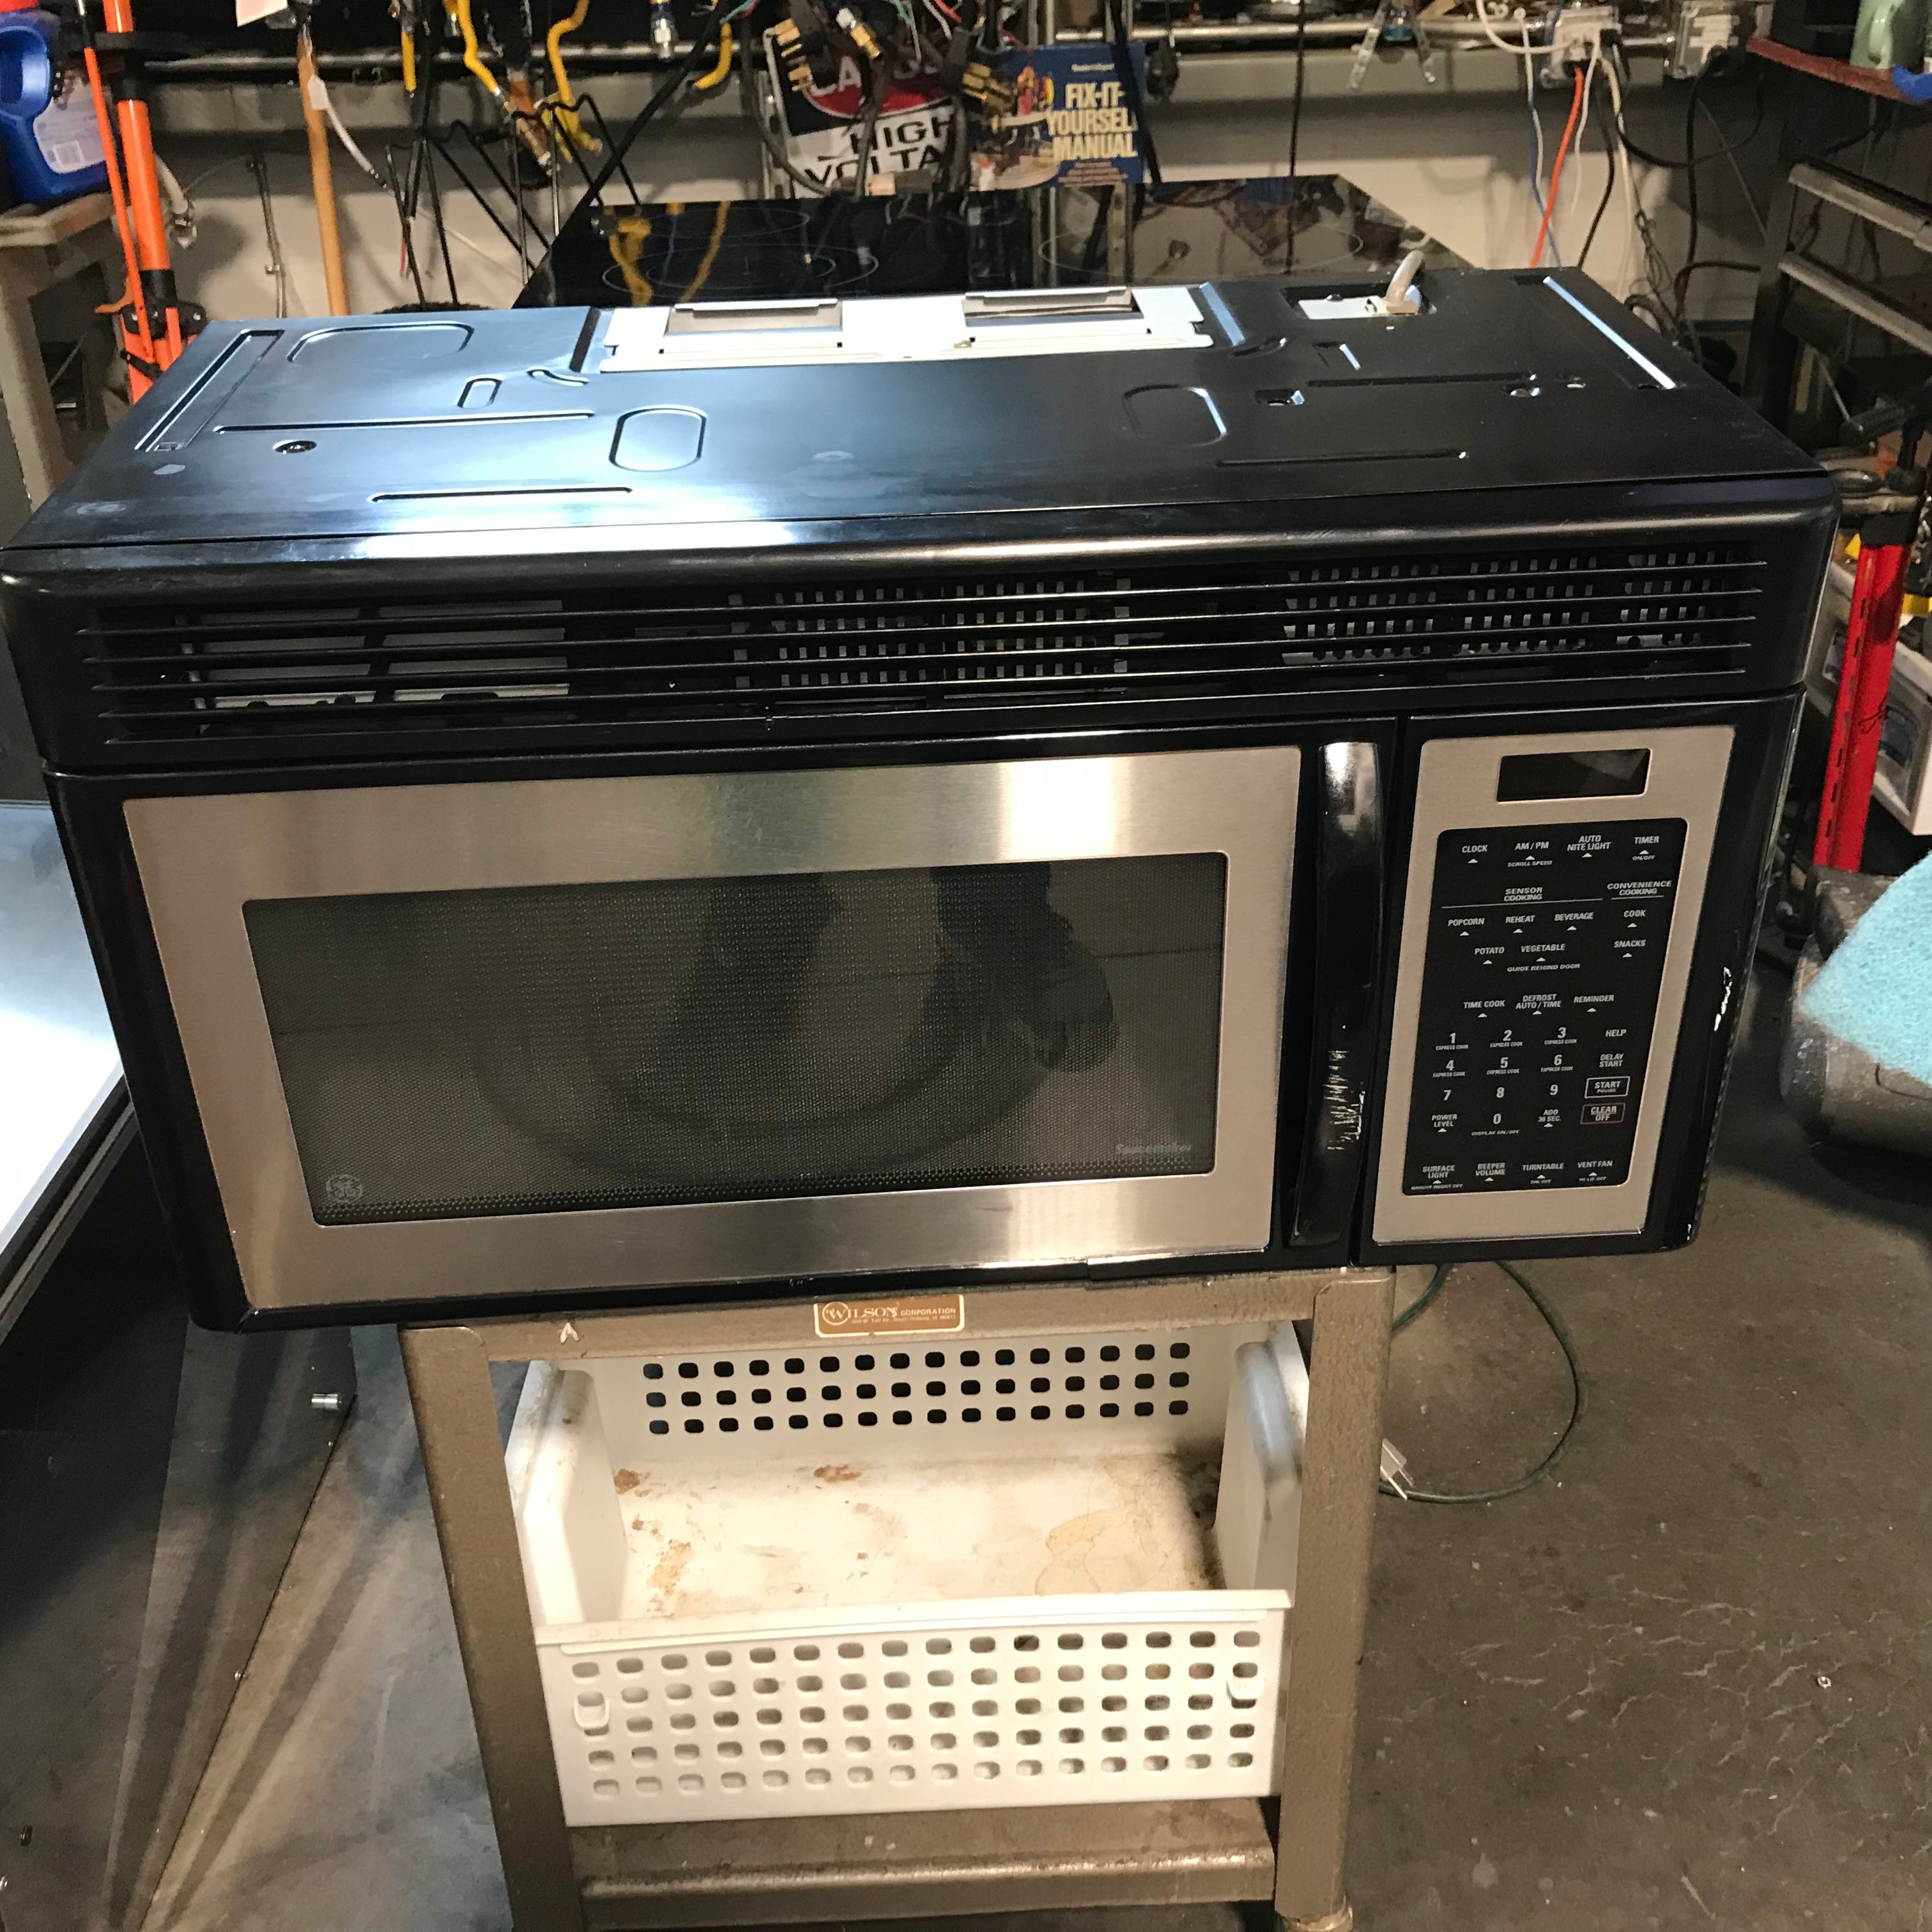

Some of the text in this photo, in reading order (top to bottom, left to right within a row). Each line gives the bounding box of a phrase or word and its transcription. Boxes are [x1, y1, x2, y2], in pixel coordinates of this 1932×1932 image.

[1046, 107, 1138, 136] YOURSEL
[850, 114, 955, 154] HIGH
[1052, 133, 1138, 160] MANUAL
[1634, 836, 1659, 844] TIMER
[1462, 845, 1487, 853] CLOCK
[1567, 841, 1611, 852] NITE LIGHT
[1607, 880, 1672, 890] CONVENIENCE
[1448, 917, 1485, 926] POPCORN
[1505, 915, 1535, 923] REHEAT
[1554, 912, 1594, 921] BEVERAGE
[1521, 943, 1565, 953] VEGETABLE
[1614, 939, 1646, 947] SNACKS
[1522, 993, 1556, 1002] DEFROST
[1574, 995, 1614, 1003] REMINDER
[1449, 1032, 1457, 1044] 1
[1503, 1030, 1512, 1041] 2
[1557, 1027, 1567, 1038] 3
[1605, 1029, 1627, 1037] HELP
[1446, 1060, 1454, 1071] 4
[1500, 1057, 1508, 1068] 5
[1553, 1054, 1562, 1066] 6
[1443, 1089, 1452, 1100] 7
[1496, 1087, 1505, 1098] 8
[1550, 1084, 1558, 1095] 9
[1493, 1114, 1501, 1124] 0
[1522, 1163, 1564, 1171] TURNTABLE
[824, 1305, 898, 1321] WILSON
[900, 1308, 956, 1316] CORPORATION
